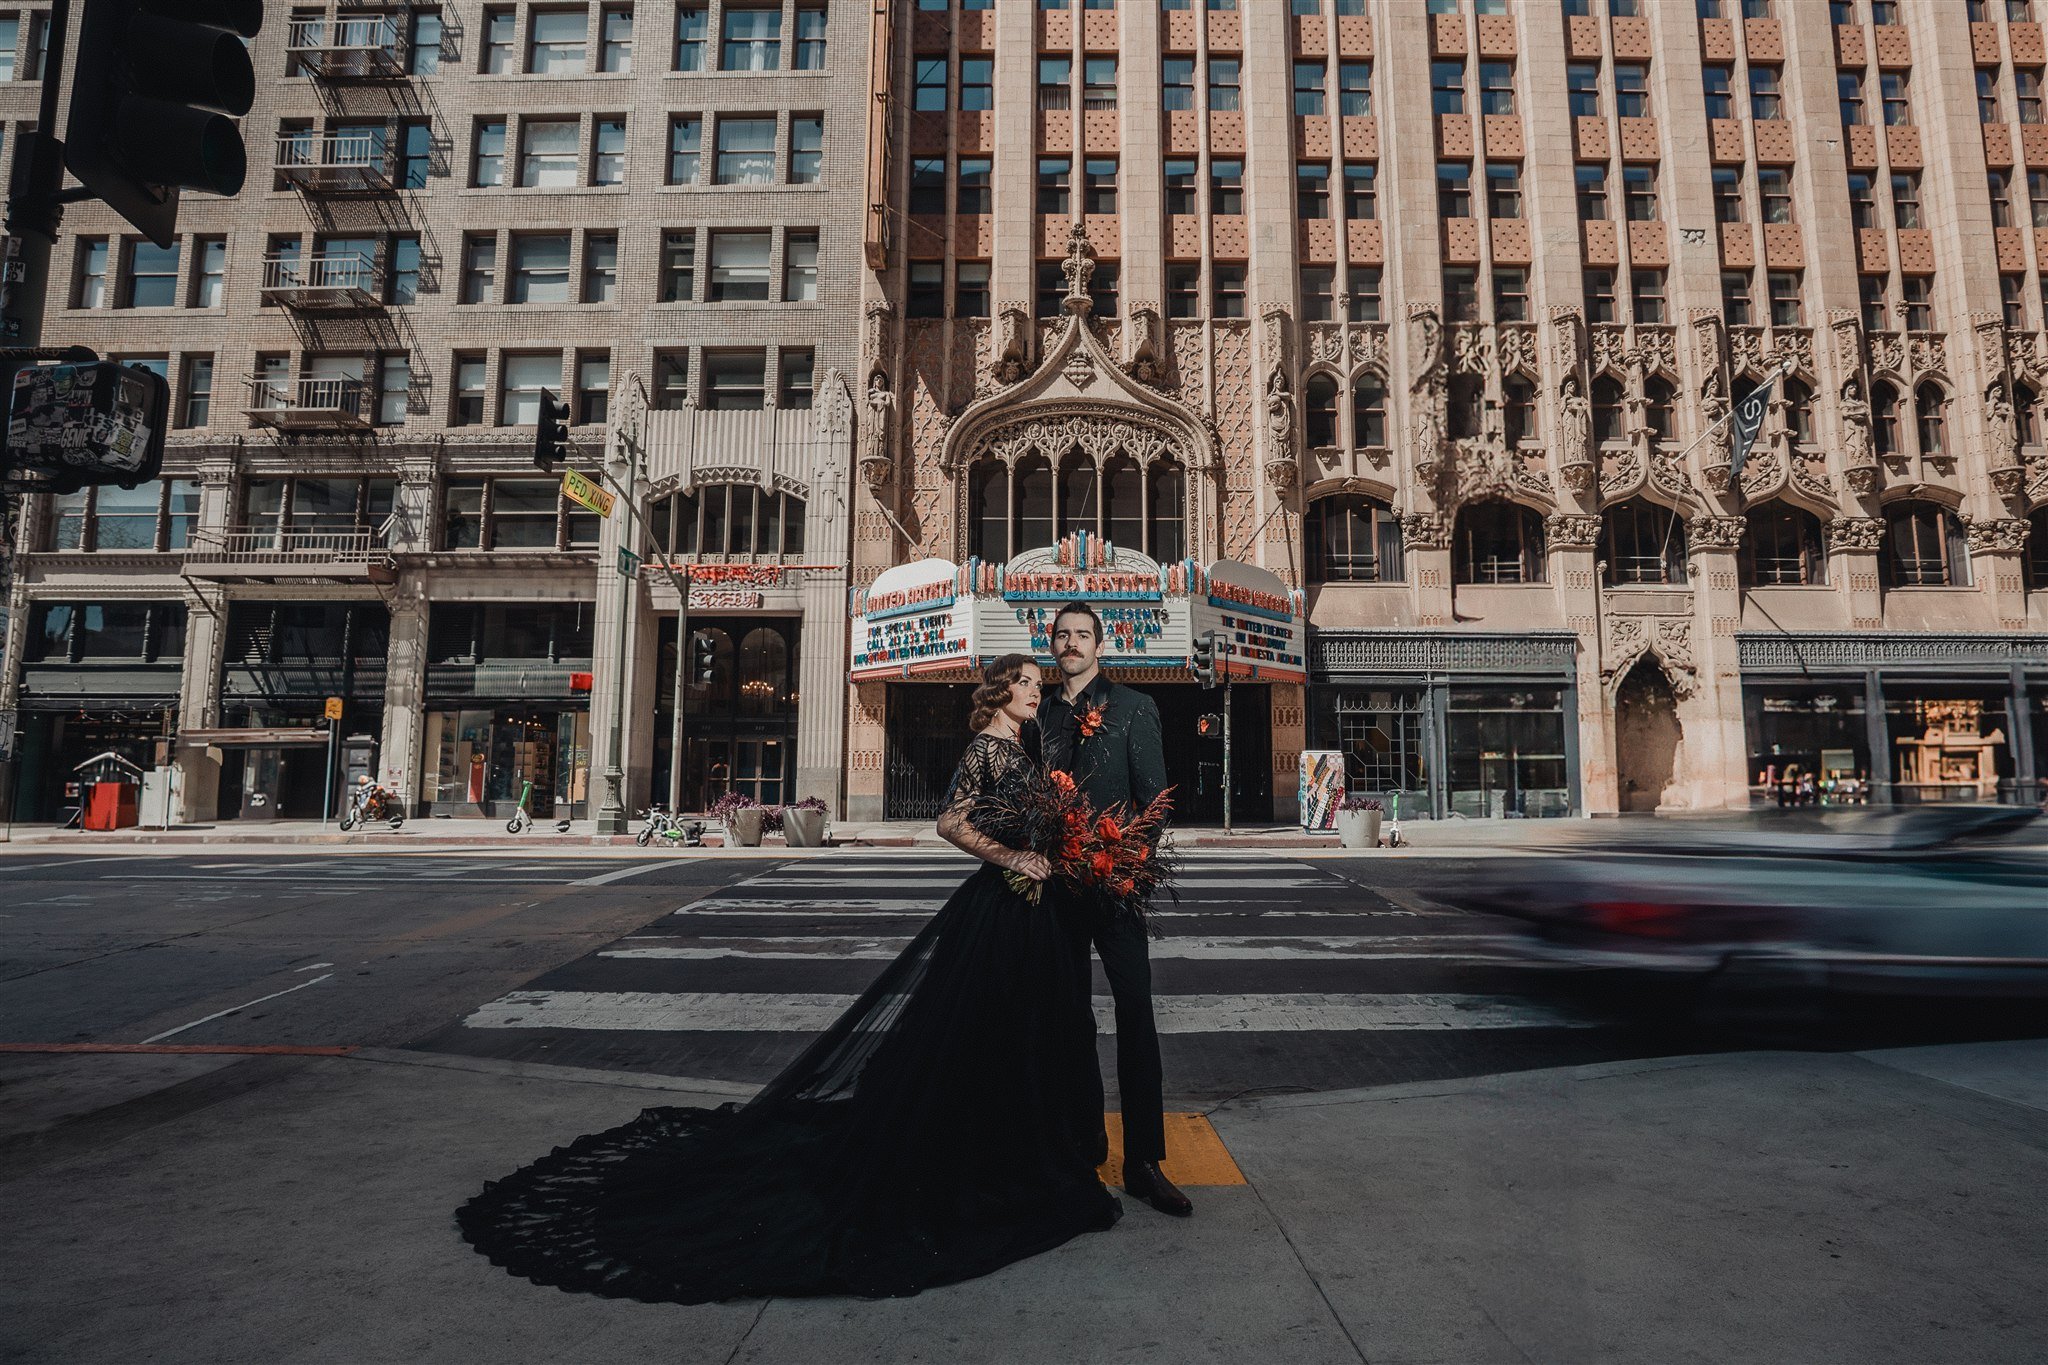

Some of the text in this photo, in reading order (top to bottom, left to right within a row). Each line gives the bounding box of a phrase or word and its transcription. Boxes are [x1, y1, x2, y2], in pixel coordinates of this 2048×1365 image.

[61, 428, 92, 448] GENIE
[566, 475, 611, 512] PED XING
[1005, 573, 1160, 592] UNITED ARTISTS
[867, 590, 906, 613] UNITED
[1016, 608, 1046, 620] CAP
[1102, 608, 1168, 621] PRESENTS
[868, 613, 953, 638] FOR SPECIAL EVENTS
[1106, 623, 1162, 635] AKOKAN
[1221, 614, 1293, 640] THE UNITED THEATER
[867, 638, 885, 651] CALL
[1115, 636, 1146, 649] 8PM
[1248, 633, 1287, 651] BROADWAY
